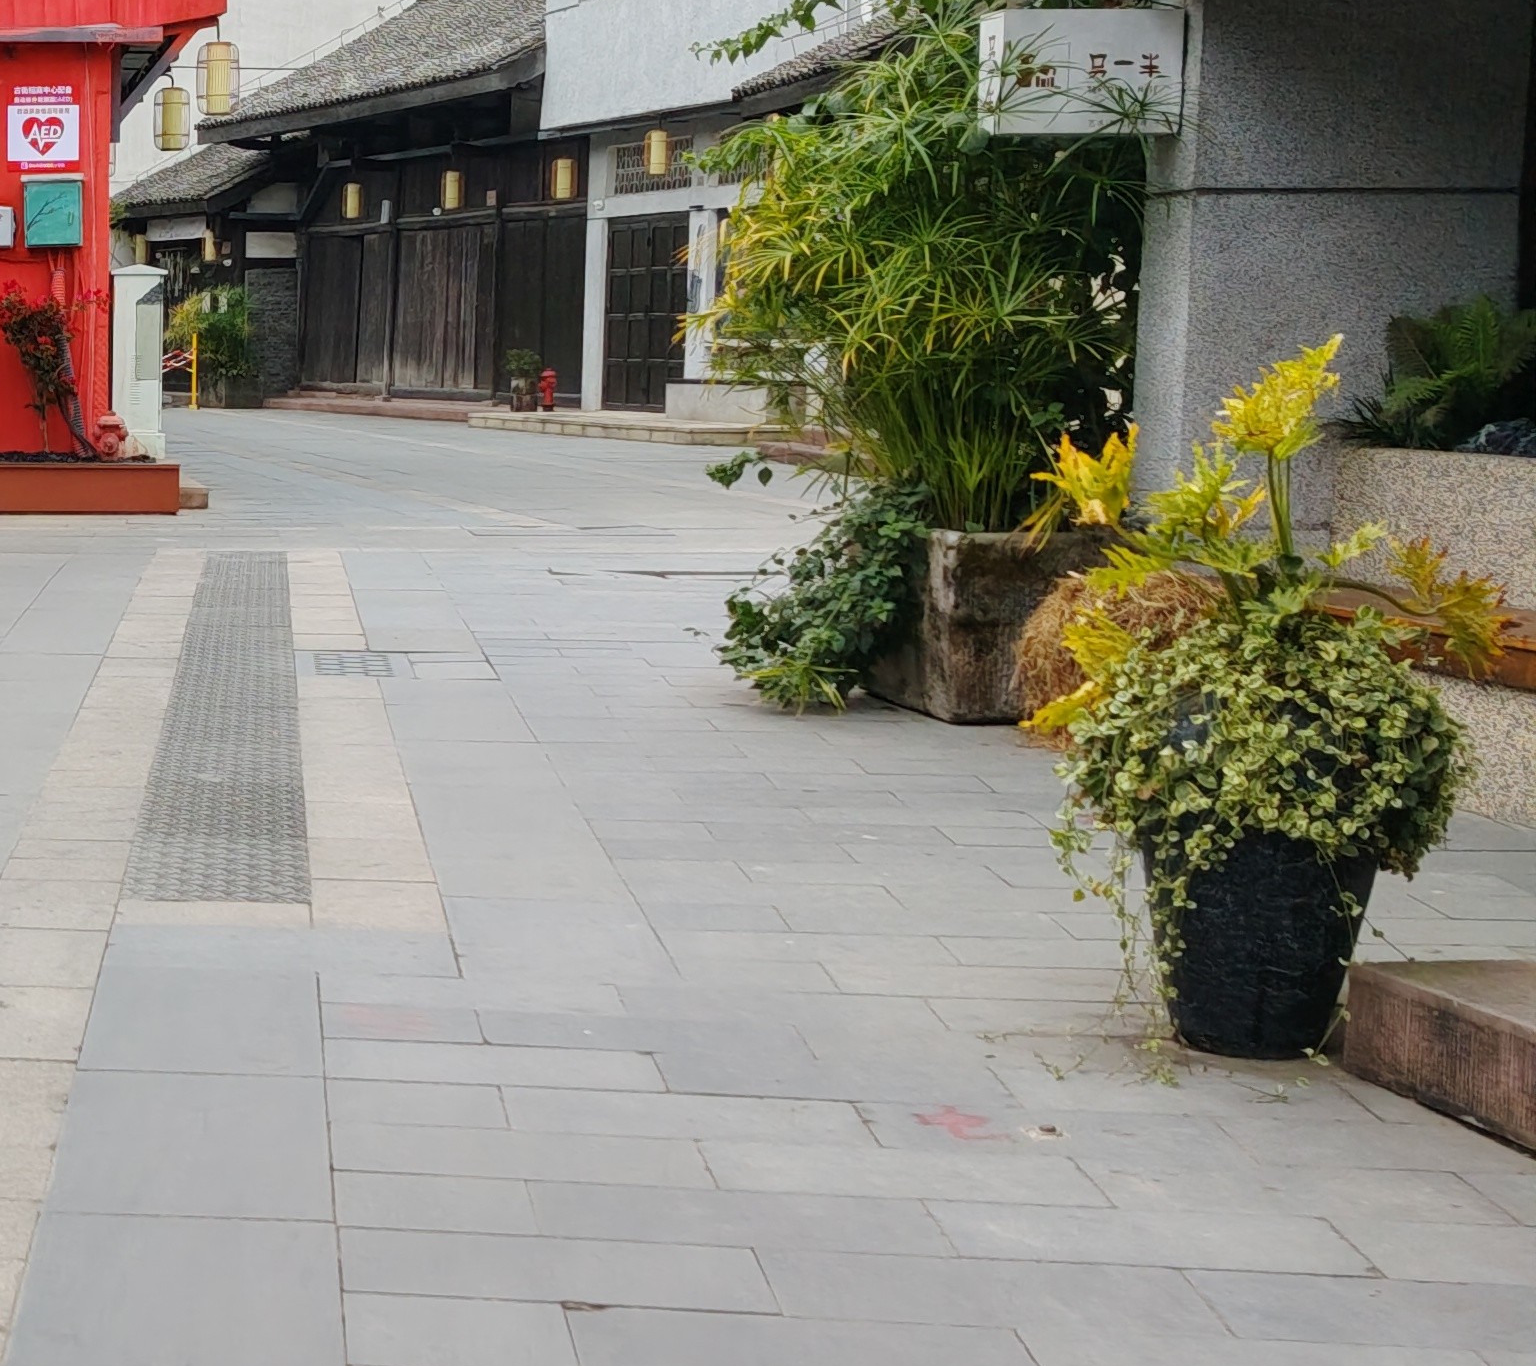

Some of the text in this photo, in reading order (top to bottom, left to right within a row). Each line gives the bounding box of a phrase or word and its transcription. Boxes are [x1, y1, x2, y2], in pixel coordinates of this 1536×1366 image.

[1089, 53, 1161, 78] 另一半
[28, 122, 62, 140] AED
